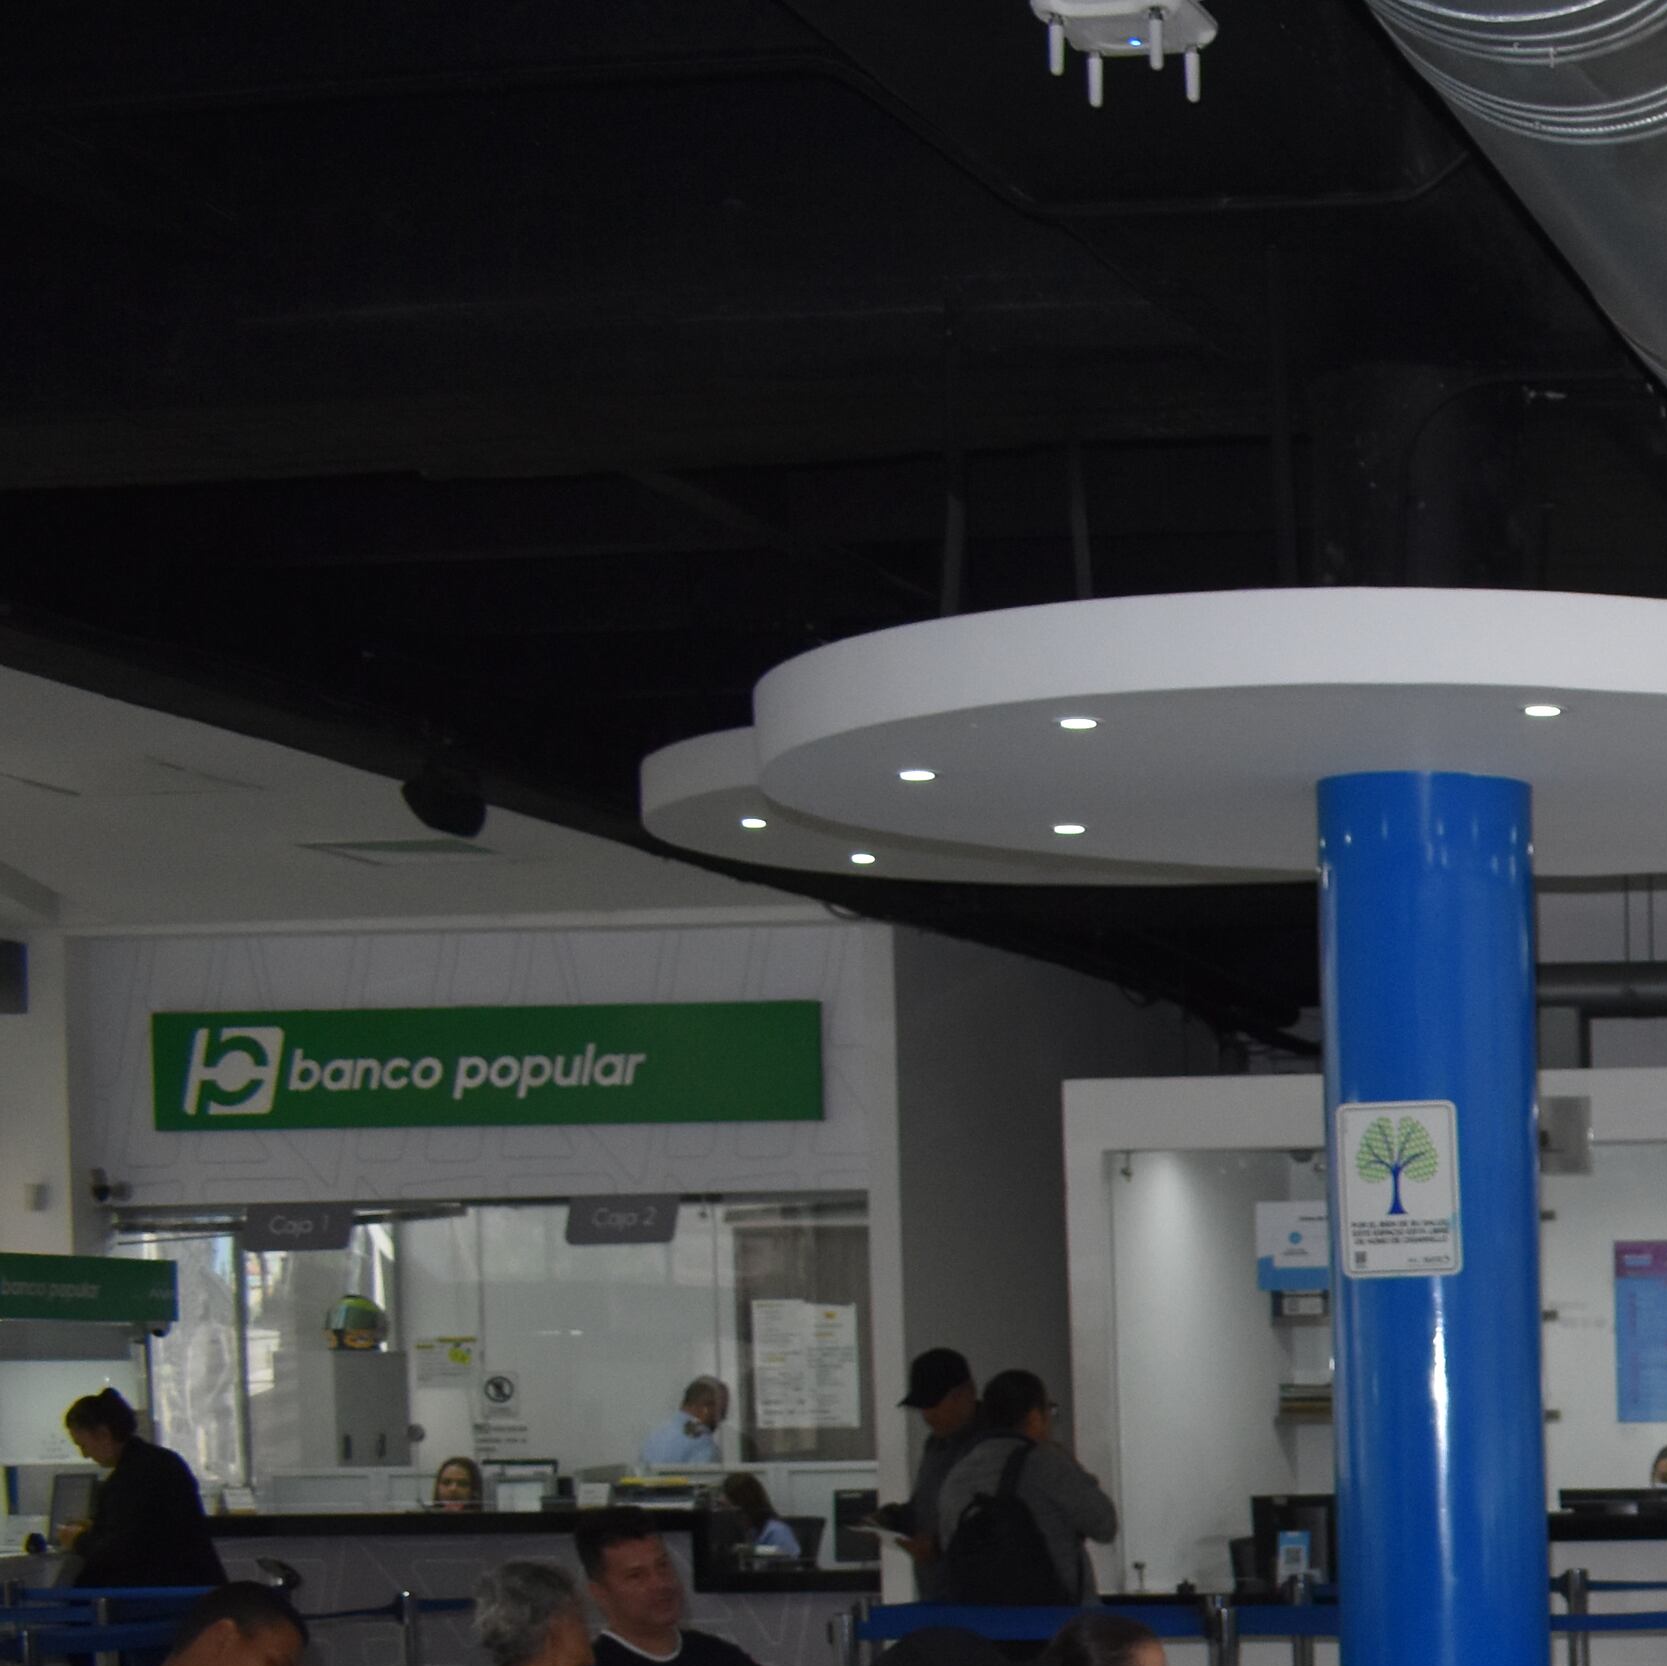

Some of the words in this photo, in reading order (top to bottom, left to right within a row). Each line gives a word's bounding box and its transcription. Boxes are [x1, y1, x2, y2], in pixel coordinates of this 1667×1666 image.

[289, 1046, 443, 1092] banco
[452, 1043, 647, 1100] popular
[268, 1212, 314, 1236] Caja
[591, 1207, 634, 1230] Caja
[639, 1205, 656, 1225] 2
